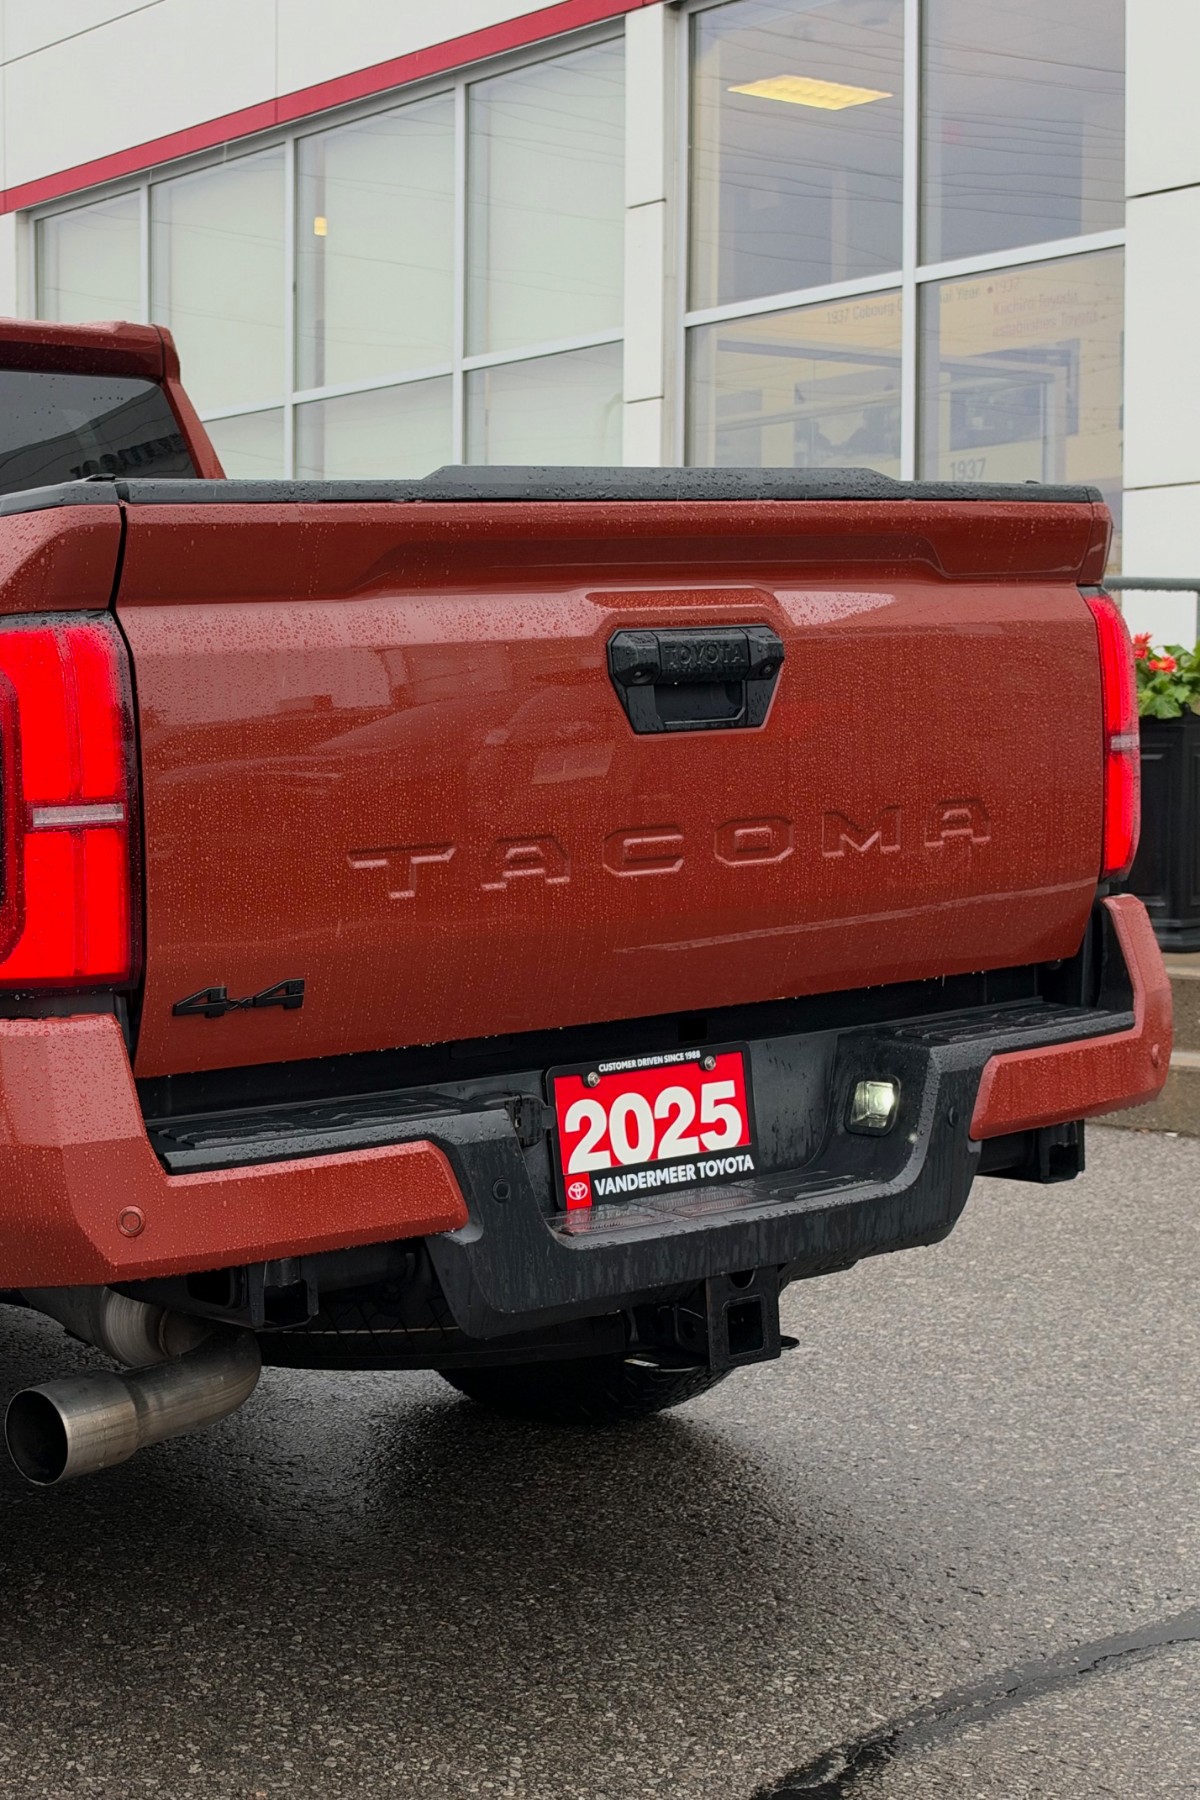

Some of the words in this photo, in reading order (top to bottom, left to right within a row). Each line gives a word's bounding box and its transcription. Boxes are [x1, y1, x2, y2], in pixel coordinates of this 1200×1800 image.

[950, 457, 987, 480] 1937
[665, 643, 745, 668] TOYOTA
[347, 799, 991, 898] TACOMA
[598, 1060, 637, 1072] CUSTOMER
[637, 1056, 663, 1067] DRIVEN
[664, 1052, 685, 1063] SINCE
[685, 1049, 701, 1060] 1988
[564, 1080, 742, 1174] 2025
[594, 1164, 697, 1196] VANDERMEER
[698, 1154, 755, 1179] TOYOTA
